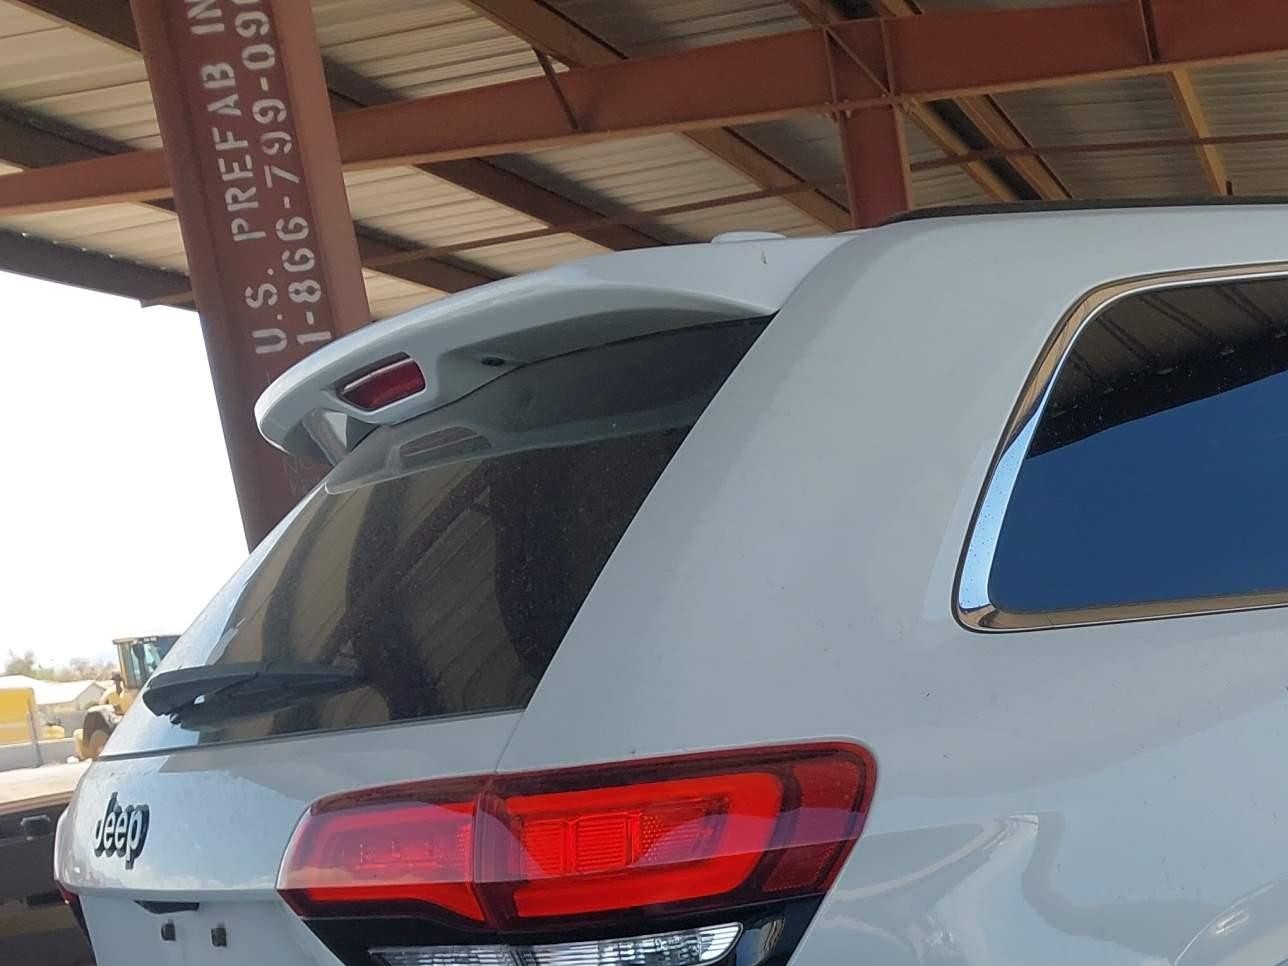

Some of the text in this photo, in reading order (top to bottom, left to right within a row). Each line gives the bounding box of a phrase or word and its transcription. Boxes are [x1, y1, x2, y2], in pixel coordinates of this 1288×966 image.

[200, 61, 266, 241] PREFAB
[231, 0, 332, 345] 1-866-799-09
[245, 267, 288, 354] U.S.
[94, 791, 150, 870] Jeep
